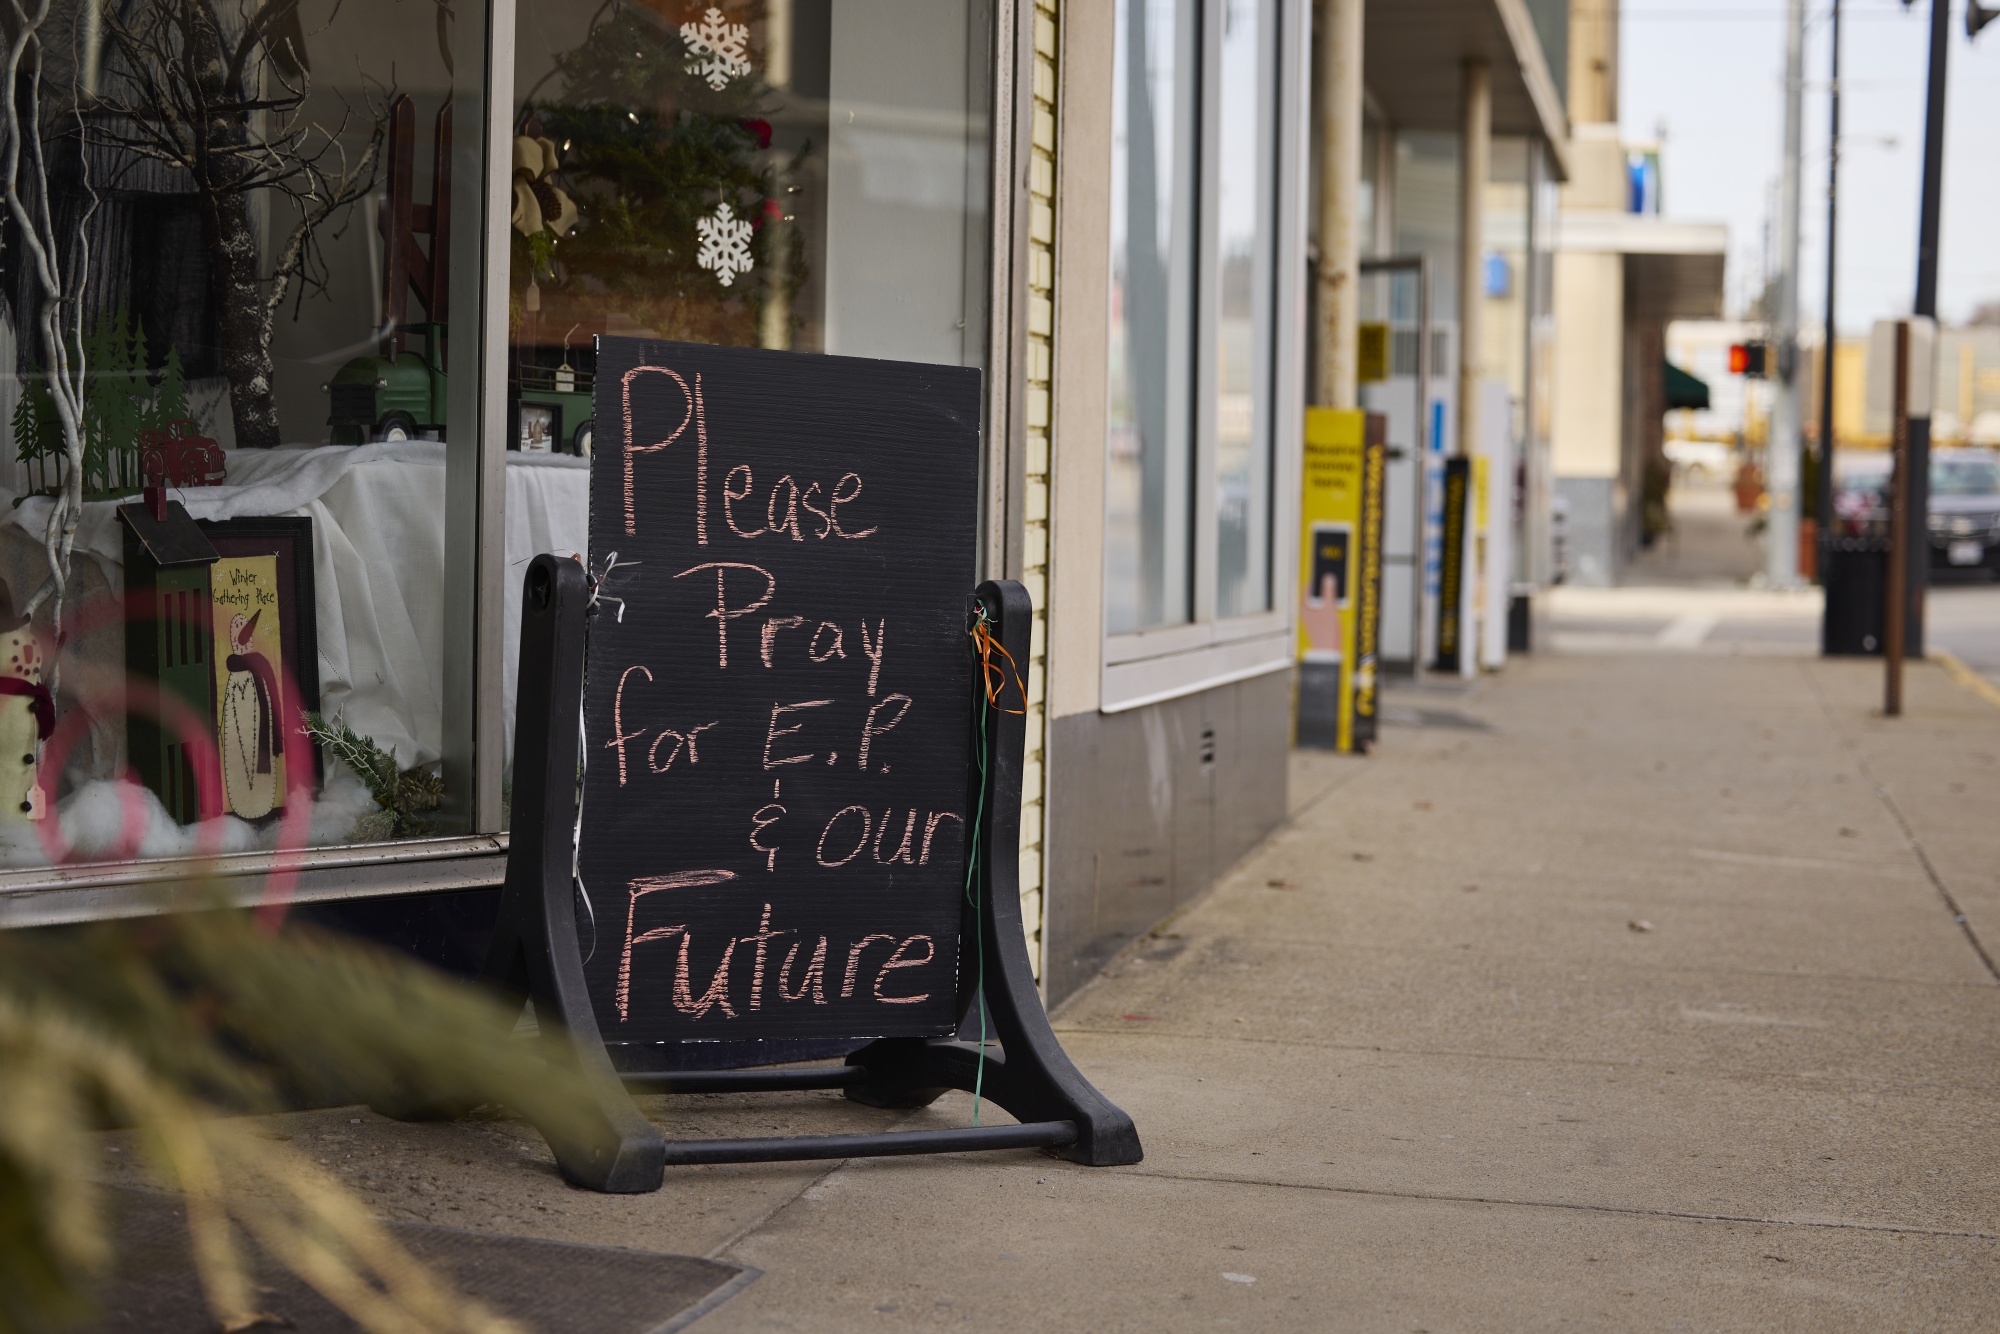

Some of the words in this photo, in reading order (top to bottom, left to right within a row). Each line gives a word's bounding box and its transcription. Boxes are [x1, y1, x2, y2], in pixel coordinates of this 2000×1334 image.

[620, 365, 878, 546] Please
[213, 588, 249, 611] Gathering
[256, 587, 275, 605] Place
[229, 568, 257, 586] Winter
[673, 562, 885, 697] Pray
[605, 665, 718, 787] for
[763, 692, 913, 774] E.P.
[749, 779, 787, 872] &
[615, 869, 935, 1022] Future
